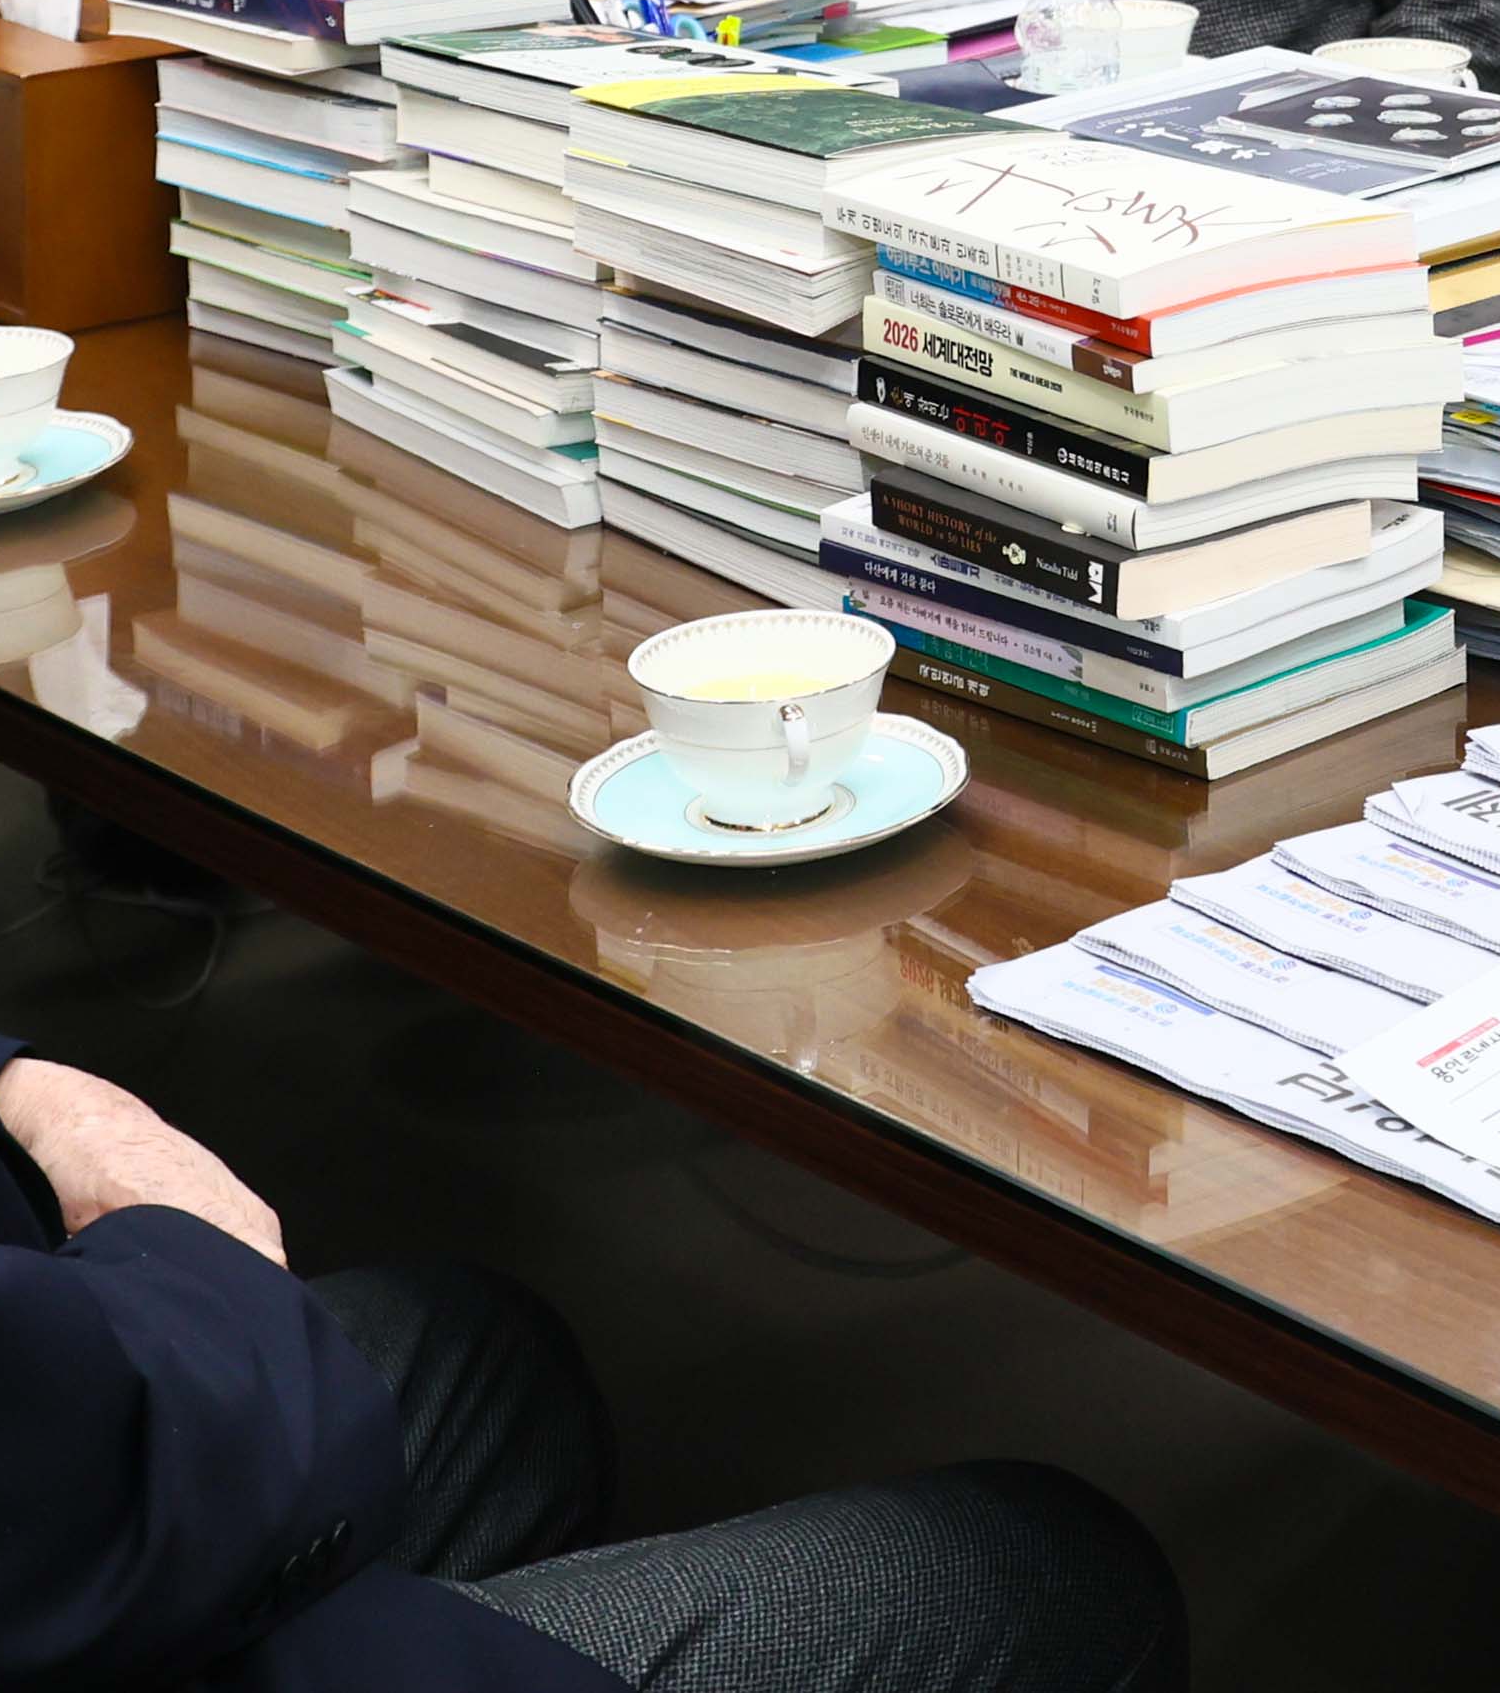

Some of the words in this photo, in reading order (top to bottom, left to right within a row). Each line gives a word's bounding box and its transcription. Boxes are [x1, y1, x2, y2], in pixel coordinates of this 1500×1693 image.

[909, 289, 937, 315] 너희는
[938, 298, 983, 333] 솔로몬에게
[984, 315, 1012, 340] 배우라
[883, 317, 919, 353] 2026
[921, 331, 994, 378] 세계대전망
[861, 425, 884, 447] 인생이
[952, 406, 1012, 448] 아리아
[892, 497, 925, 518] SHORT
[927, 508, 973, 535] HISTORY
[898, 515, 933, 536] WORLD
[960, 537, 982, 554] LIES
[864, 561, 899, 585] 다산에게
[899, 570, 918, 588] 길을
[979, 626, 1009, 648] 드립니다
